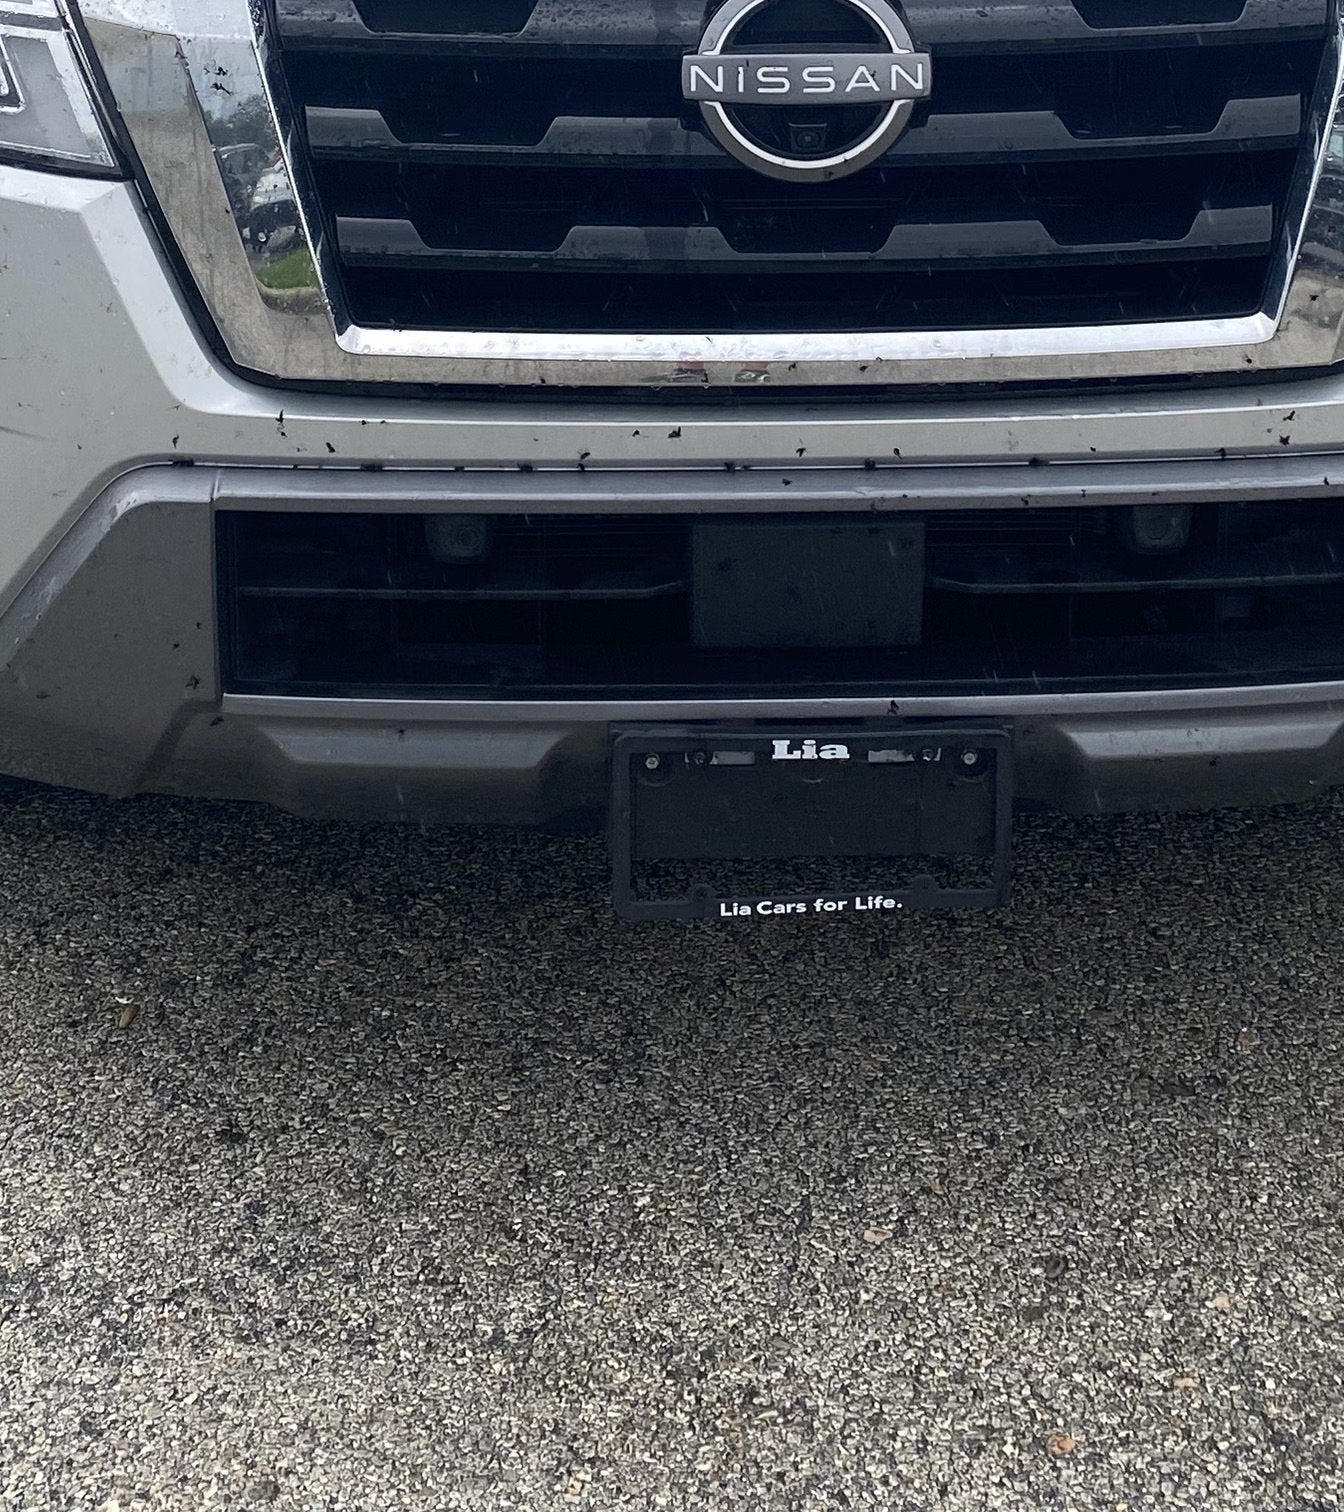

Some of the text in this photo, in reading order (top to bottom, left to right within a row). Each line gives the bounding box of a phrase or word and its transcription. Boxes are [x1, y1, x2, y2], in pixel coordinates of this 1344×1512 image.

[690, 63, 924, 94] NISSAN
[771, 739, 850, 761] Lia
[719, 895, 904, 917] Lia Cars for Life.
